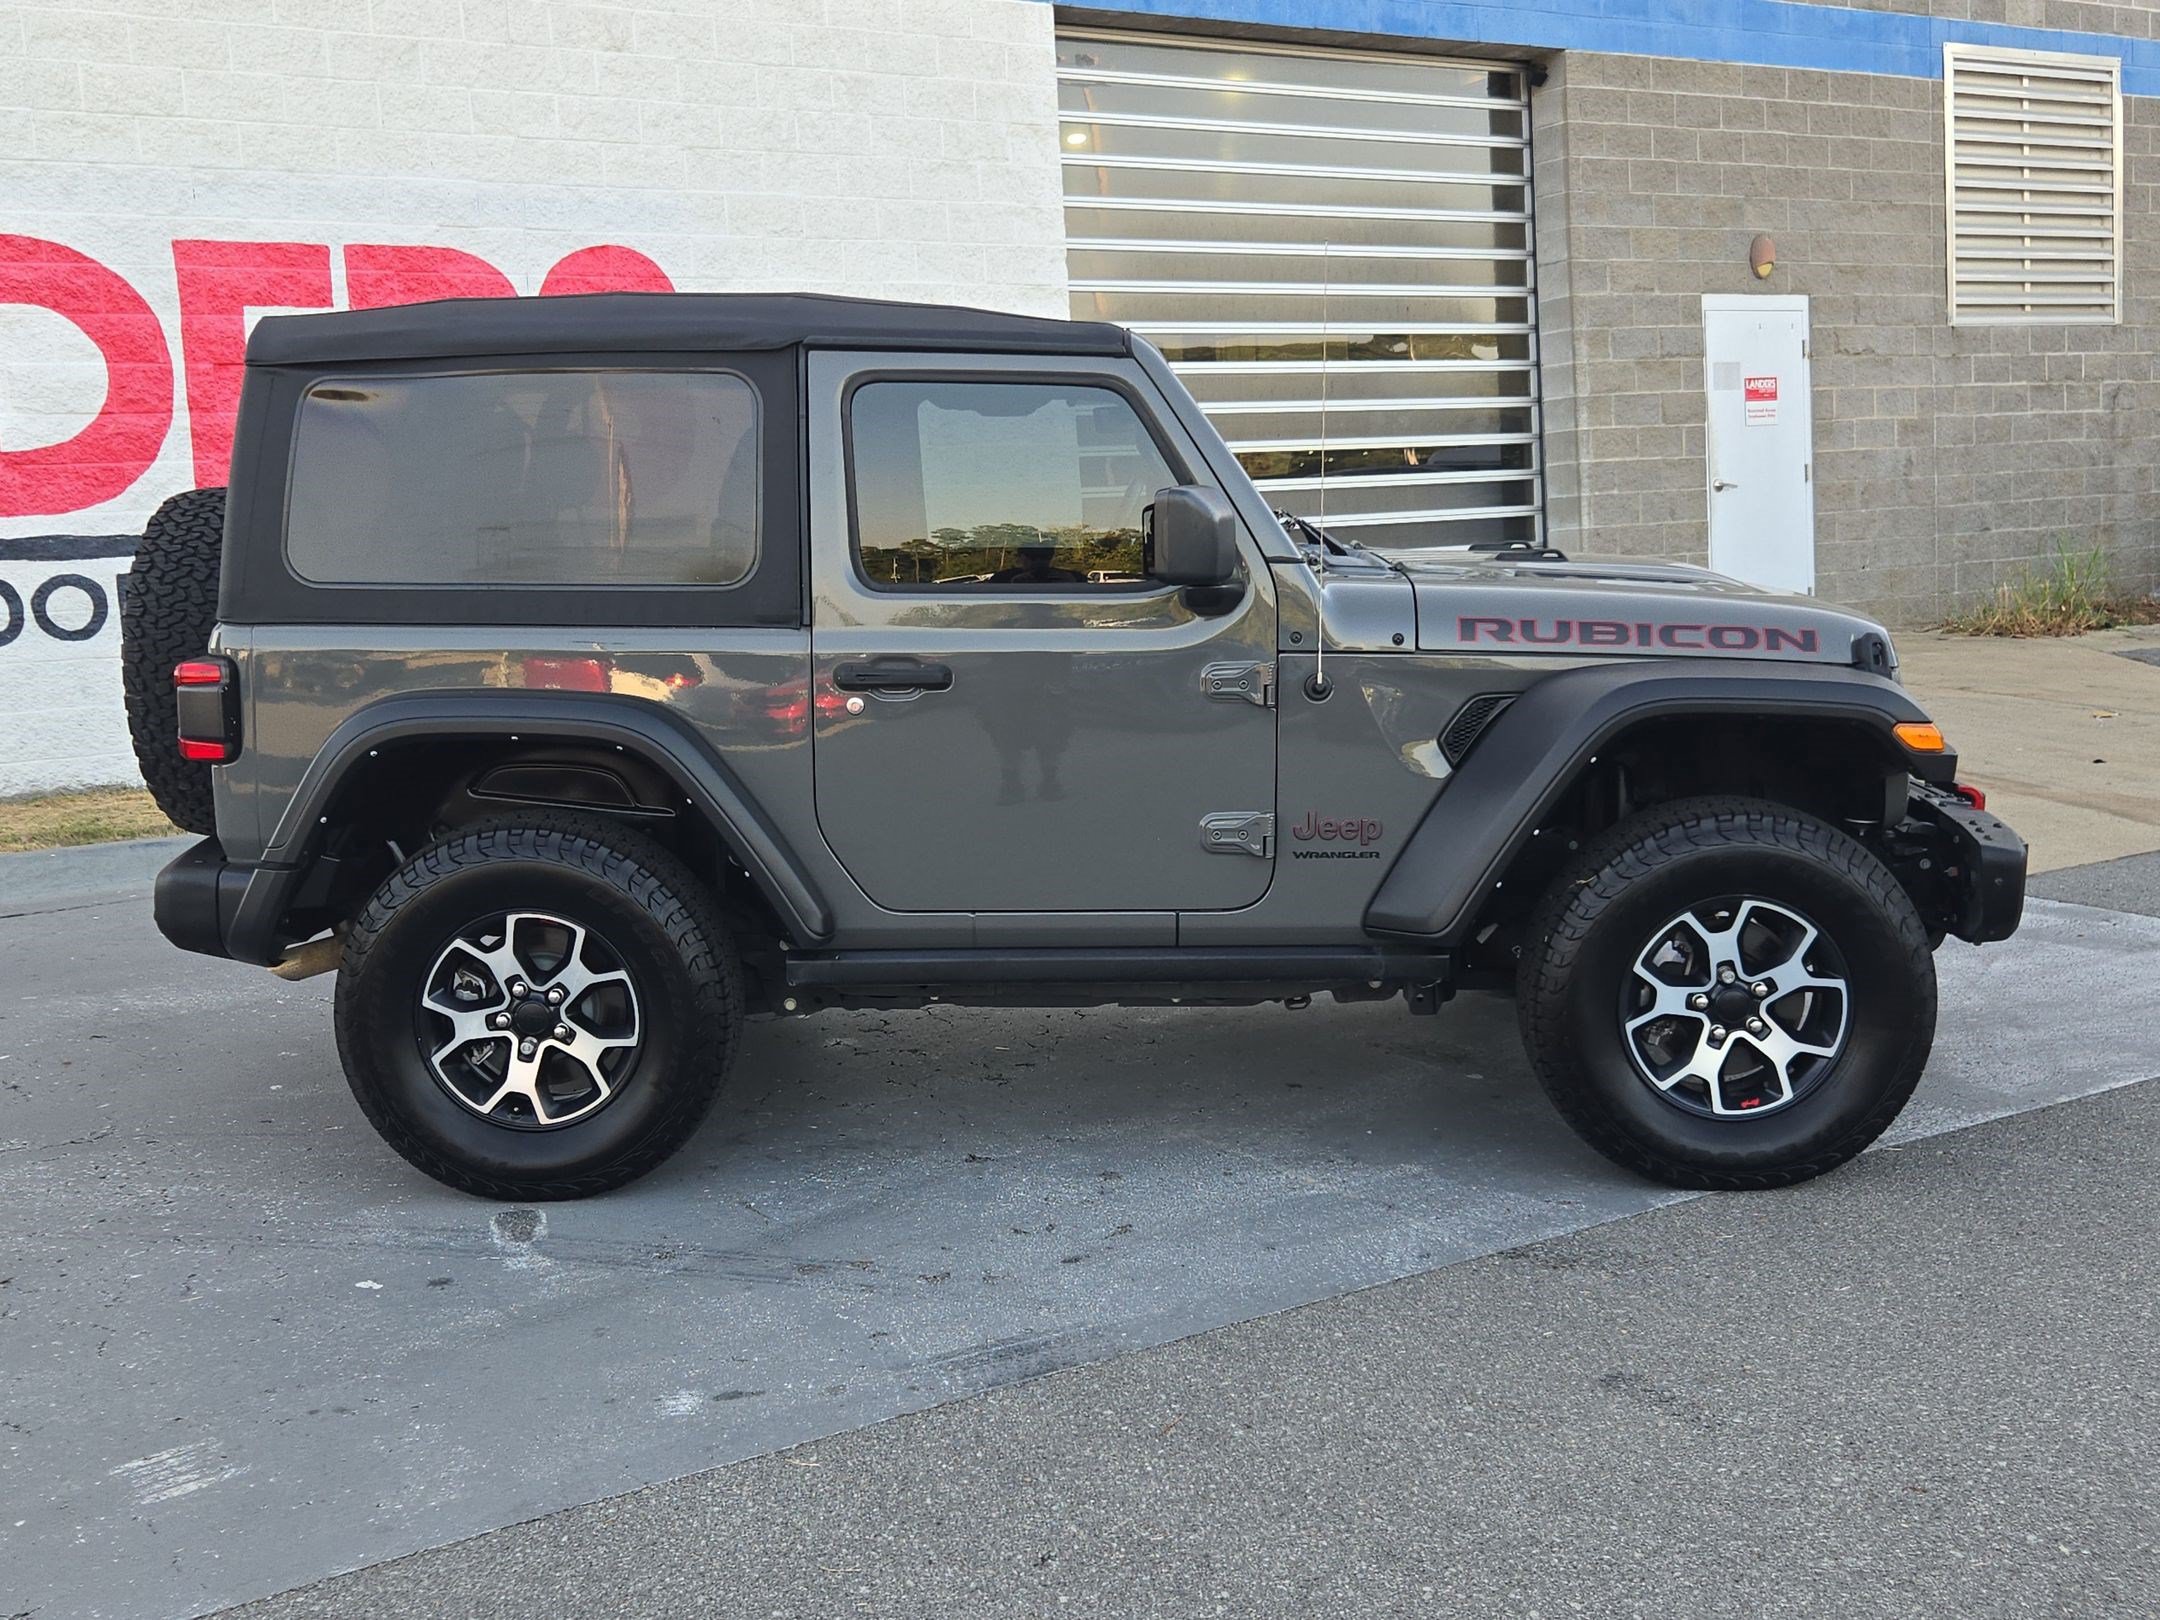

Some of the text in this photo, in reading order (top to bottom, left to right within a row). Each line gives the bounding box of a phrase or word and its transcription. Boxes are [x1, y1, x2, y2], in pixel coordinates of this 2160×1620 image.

[1745, 379, 1776, 390] LANDERS
[1458, 616, 1820, 652] RUBICON
[1292, 810, 1383, 846] Jeep
[1292, 850, 1380, 860] WRANGLER
